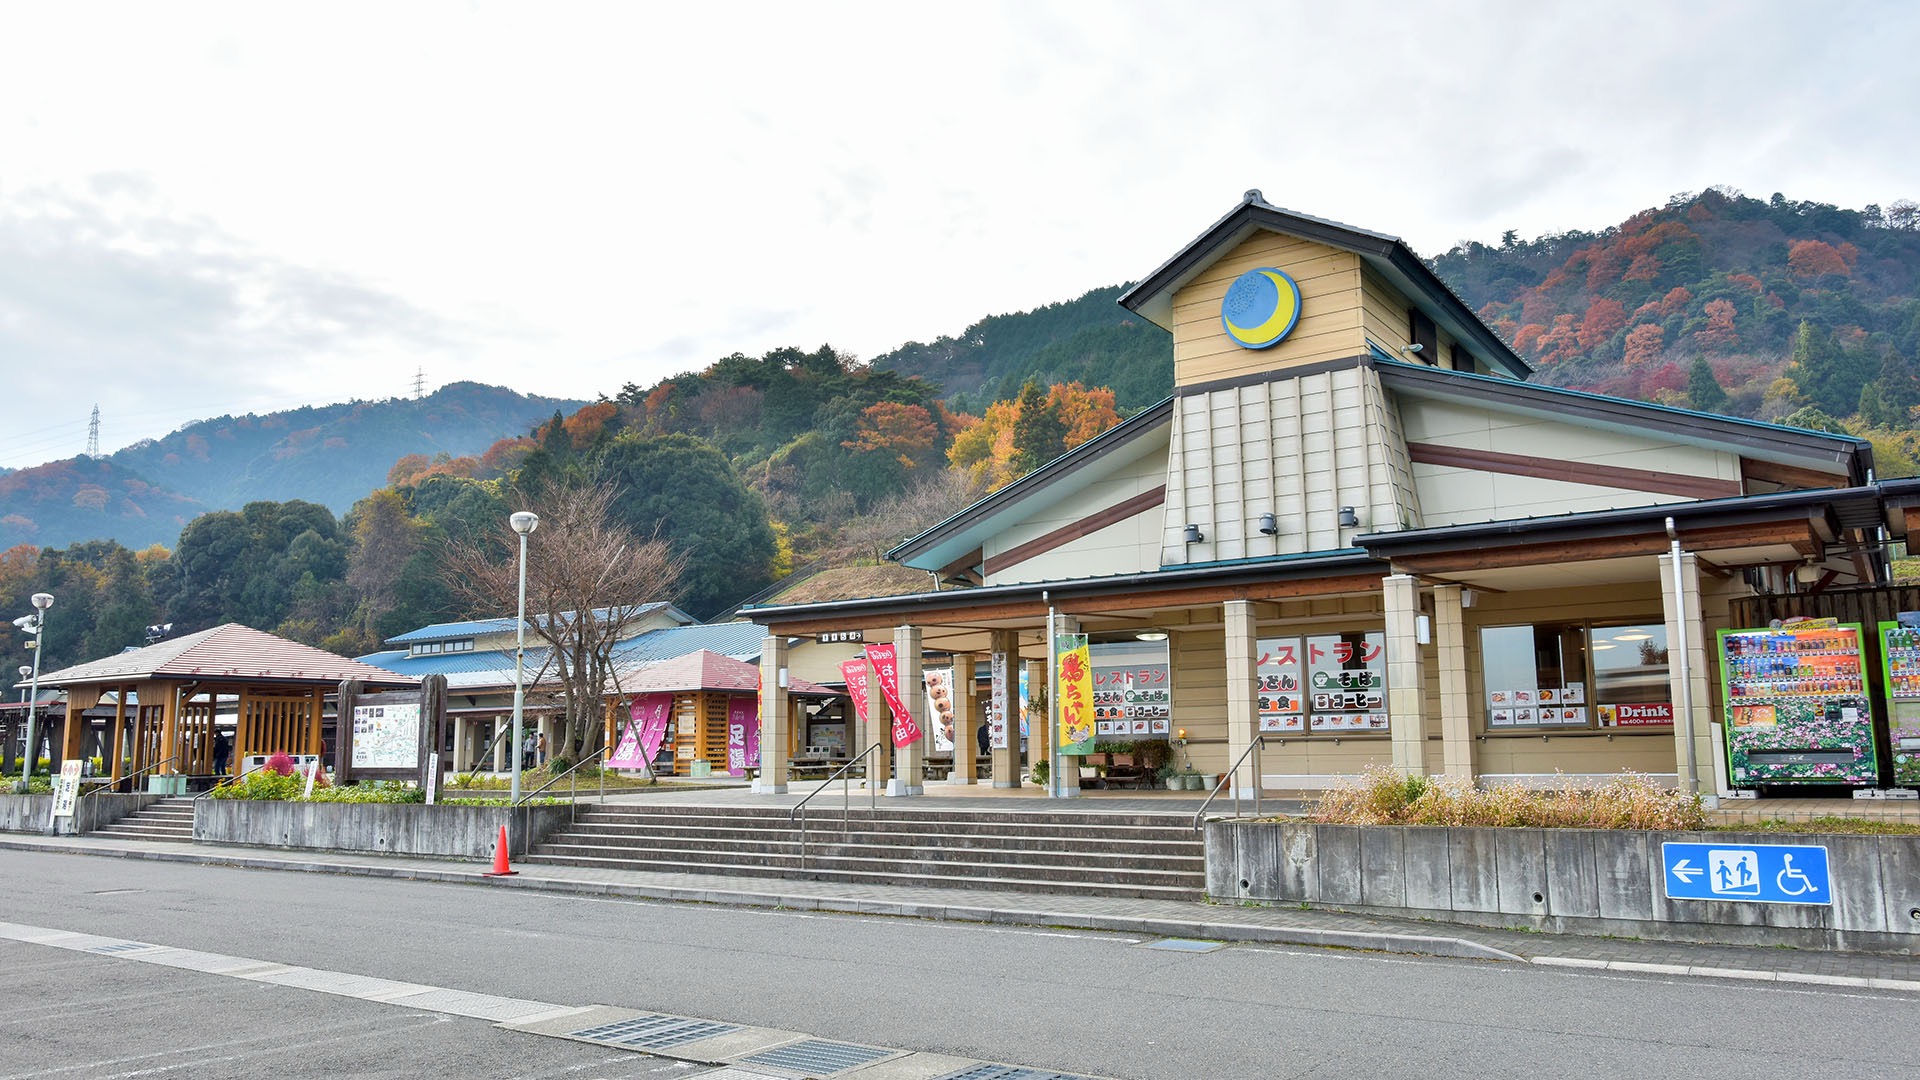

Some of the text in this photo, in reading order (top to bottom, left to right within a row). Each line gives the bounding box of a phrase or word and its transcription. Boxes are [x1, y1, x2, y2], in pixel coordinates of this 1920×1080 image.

[1095, 670, 1166, 685] レストラン
[1338, 672, 1373, 687] そば
[1060, 653, 1084, 725] 鶏ちゃん
[1141, 690, 1163, 701] そば
[1093, 692, 1121, 702] うどん
[1258, 695, 1291, 710] 定食
[1333, 693, 1379, 708] コーヒー
[1137, 706, 1167, 716] コーヒー
[1620, 705, 1670, 718] Drink
[728, 723, 746, 769] 足湯
